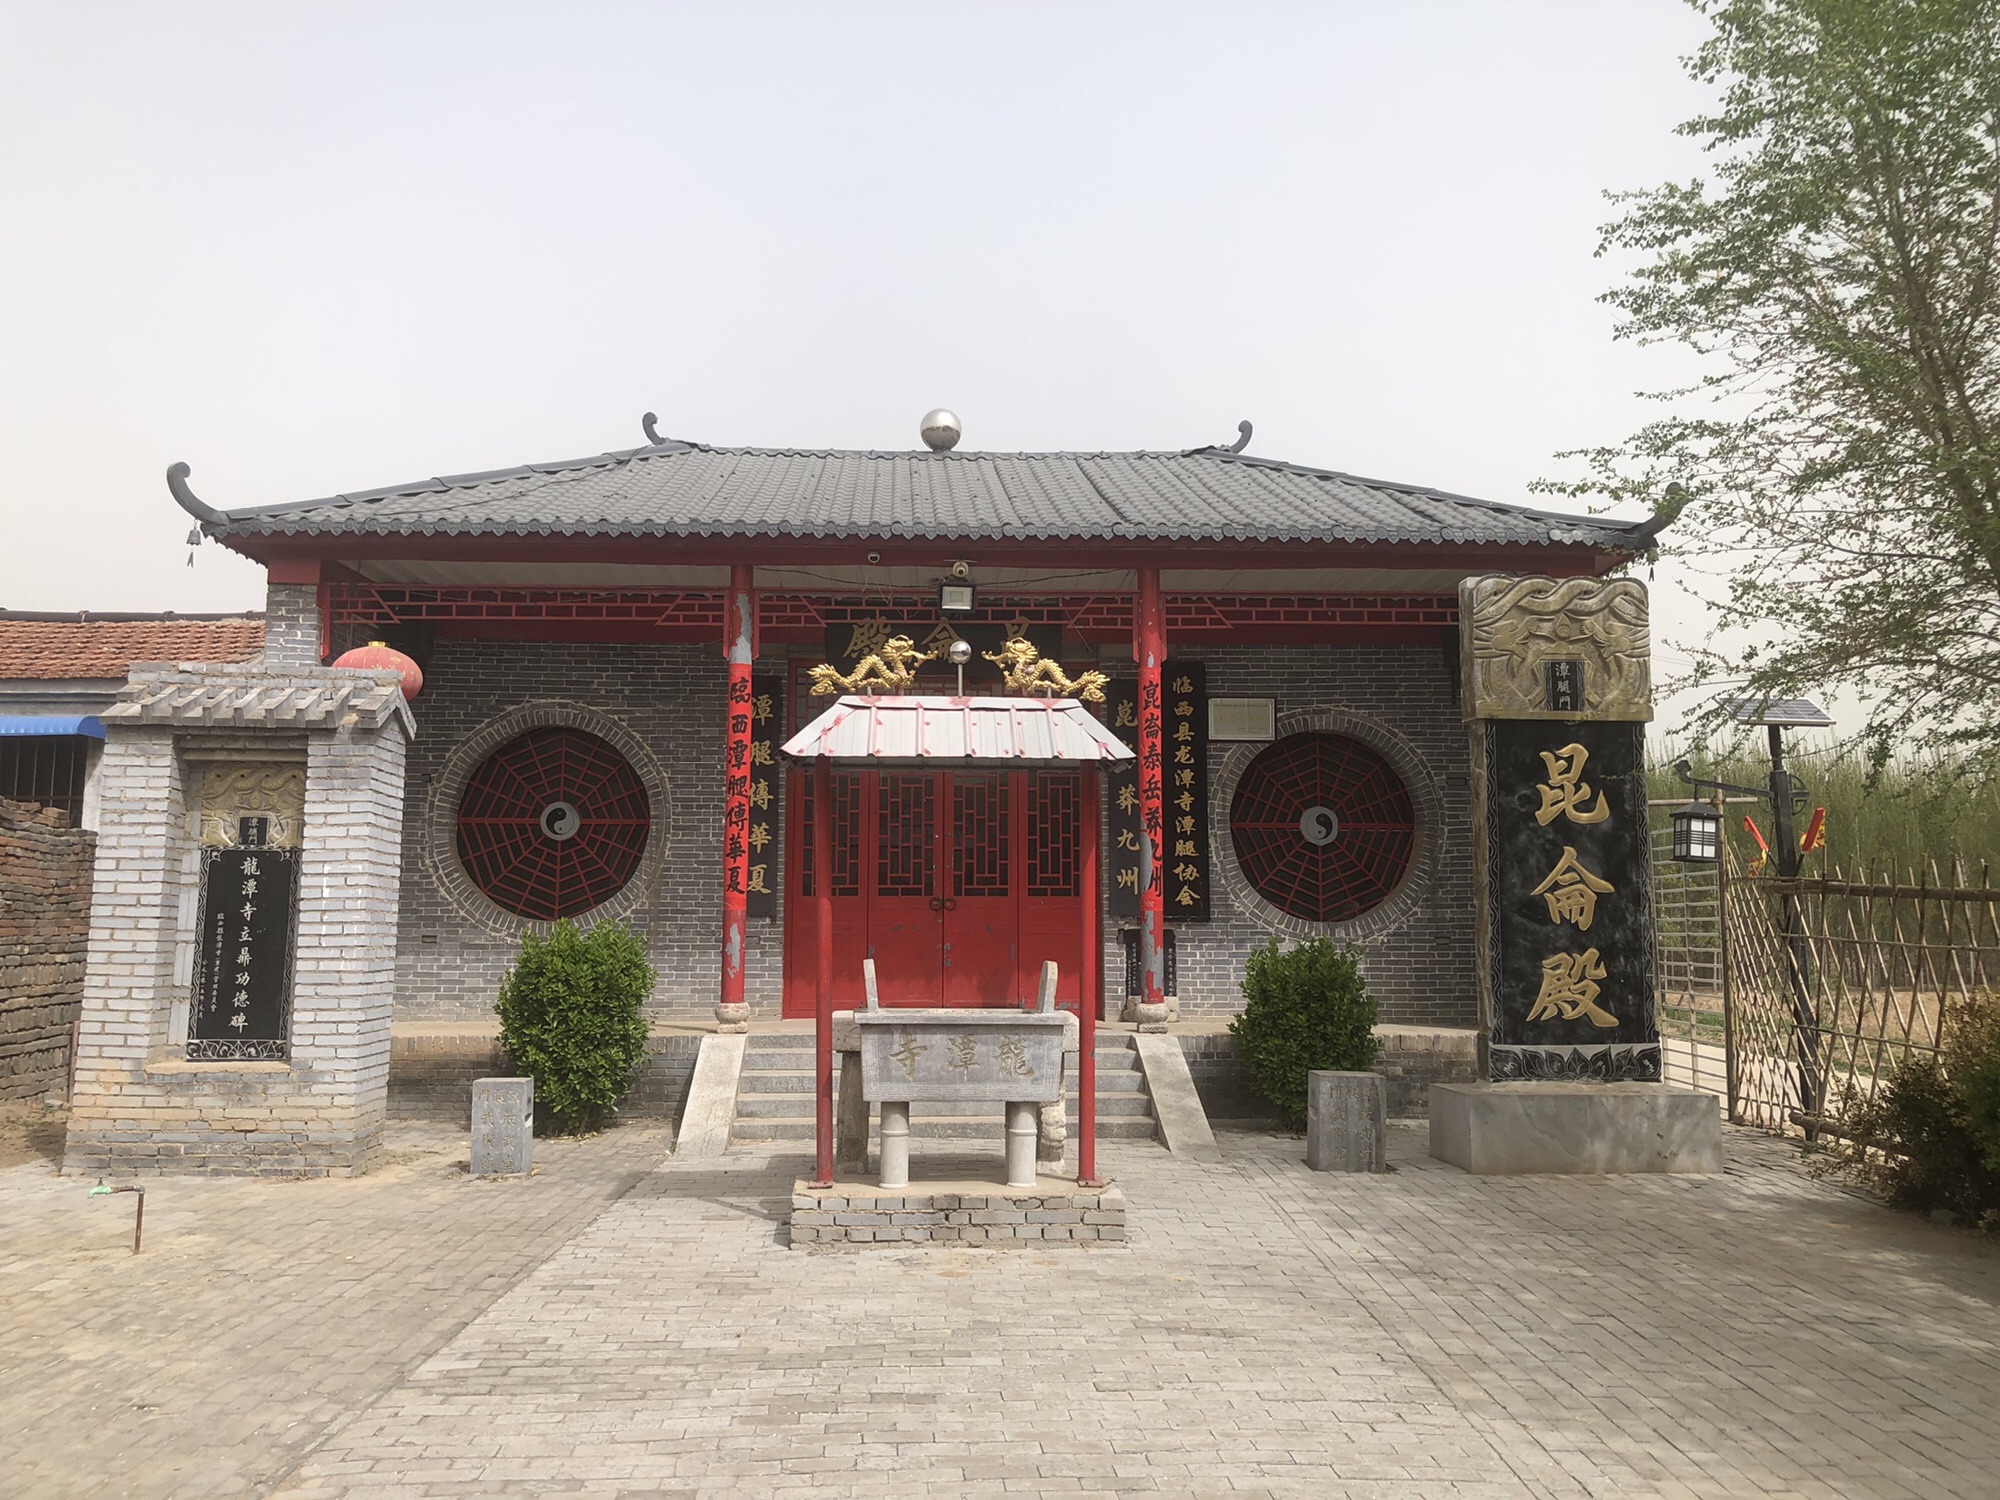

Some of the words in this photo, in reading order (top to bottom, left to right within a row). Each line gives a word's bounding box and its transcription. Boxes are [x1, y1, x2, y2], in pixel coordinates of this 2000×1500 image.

[726, 677, 750, 894] 臨西潭腿傳華夏
[1555, 662, 1571, 710] 潭腿門
[748, 693, 775, 894] 潭腿傳華夏
[1115, 699, 1139, 896] 崑莽九州
[1172, 675, 1201, 906] 临西县龙潭寺潭腿协会
[1526, 742, 1619, 1028] 昆侖殿
[228, 856, 262, 1035] 龍潭寺立鼎功德碑
